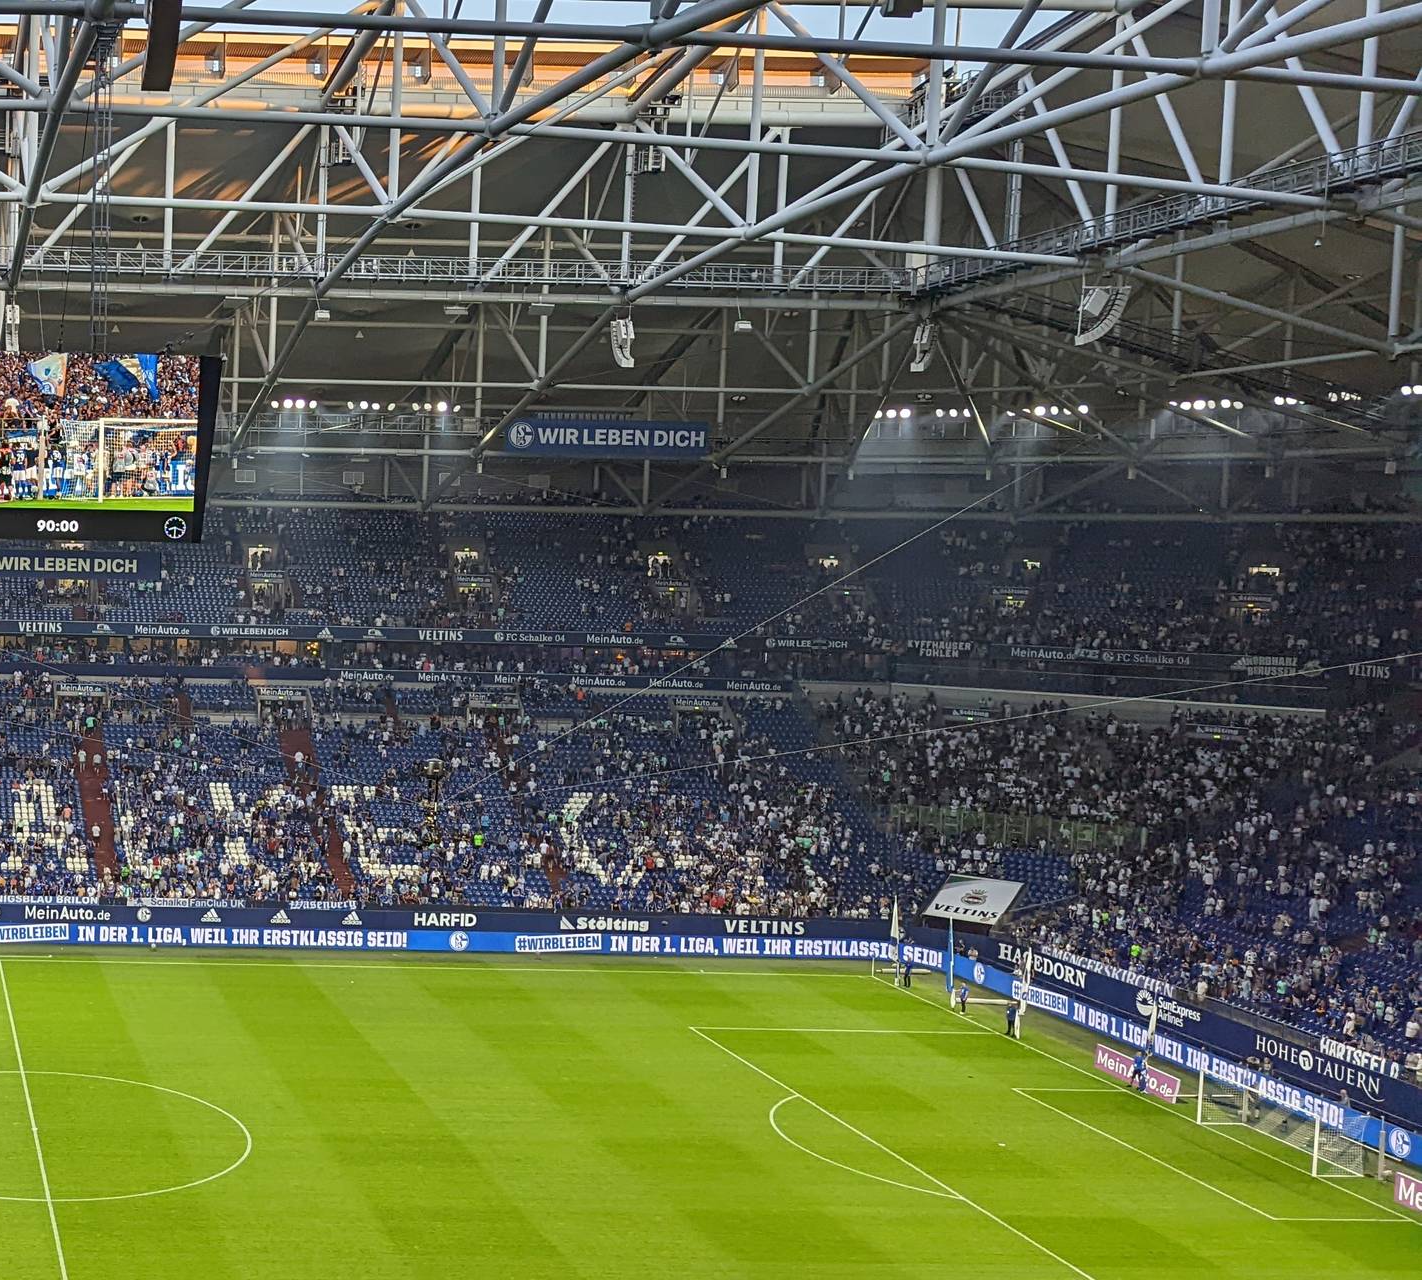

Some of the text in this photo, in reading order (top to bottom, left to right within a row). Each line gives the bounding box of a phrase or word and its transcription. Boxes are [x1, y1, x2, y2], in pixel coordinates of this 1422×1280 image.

[538, 428, 705, 448] WIR LEBEN DICH
[36, 519, 79, 533] 90:00
[34, 557, 91, 573] LEBEN
[94, 558, 137, 574] DICH
[18, 622, 63, 633] VELTINS
[134, 625, 190, 636] MeinAuto.de
[222, 627, 289, 636] WIR LEBEN DICH
[419, 630, 463, 641] VELTINS
[506, 632, 565, 642] FC Schalke 04
[586, 634, 644, 645] MeinAuto.de
[778, 639, 795, 647] WIR
[1117, 654, 1131, 662] FC
[1177, 656, 1190, 665] 04
[340, 670, 394, 681] MeinAuto.de
[1348, 664, 1390, 679] VELTINS
[572, 676, 626, 687] MeinAuto.de
[649, 678, 704, 689] MeinAuto.de
[727, 681, 782, 692] MeinAuto.de
[60, 684, 102, 693] MeinAuto.de
[260, 688, 302, 697] MeinAuto.de
[56, 895, 99, 905] BRILON
[150, 898, 187, 908] Schalke
[230, 900, 246, 908] UK
[25, 905, 111, 921] MeinAuto.de
[934, 903, 998, 920] VELTINS
[414, 912, 477, 928] HARFID
[576, 916, 650, 932] Stölting
[724, 919, 805, 935] VELTINS
[78, 926, 98, 941] IN
[100, 926, 127, 942] DER
[131, 927, 143, 942] 1.
[147, 927, 187, 946] LIGA,
[191, 928, 227, 945] WEIL
[232, 928, 259, 945] IHR
[263, 929, 363, 947] ERSTKLASSIG
[367, 930, 407, 948] SEID!
[517, 935, 943, 968] #WIRBLEIBEN IN DER 1. LIGA, WEIL IHR ERSTKLASSIG SEID!
[1157, 996, 1201, 1021] SunExpress
[1157, 1009, 1184, 1028] Airlines
[1073, 1002, 1344, 1130] IN DER 1. WEIL IHR SEID!
[1256, 1034, 1385, 1102] HOHE TAUERN
